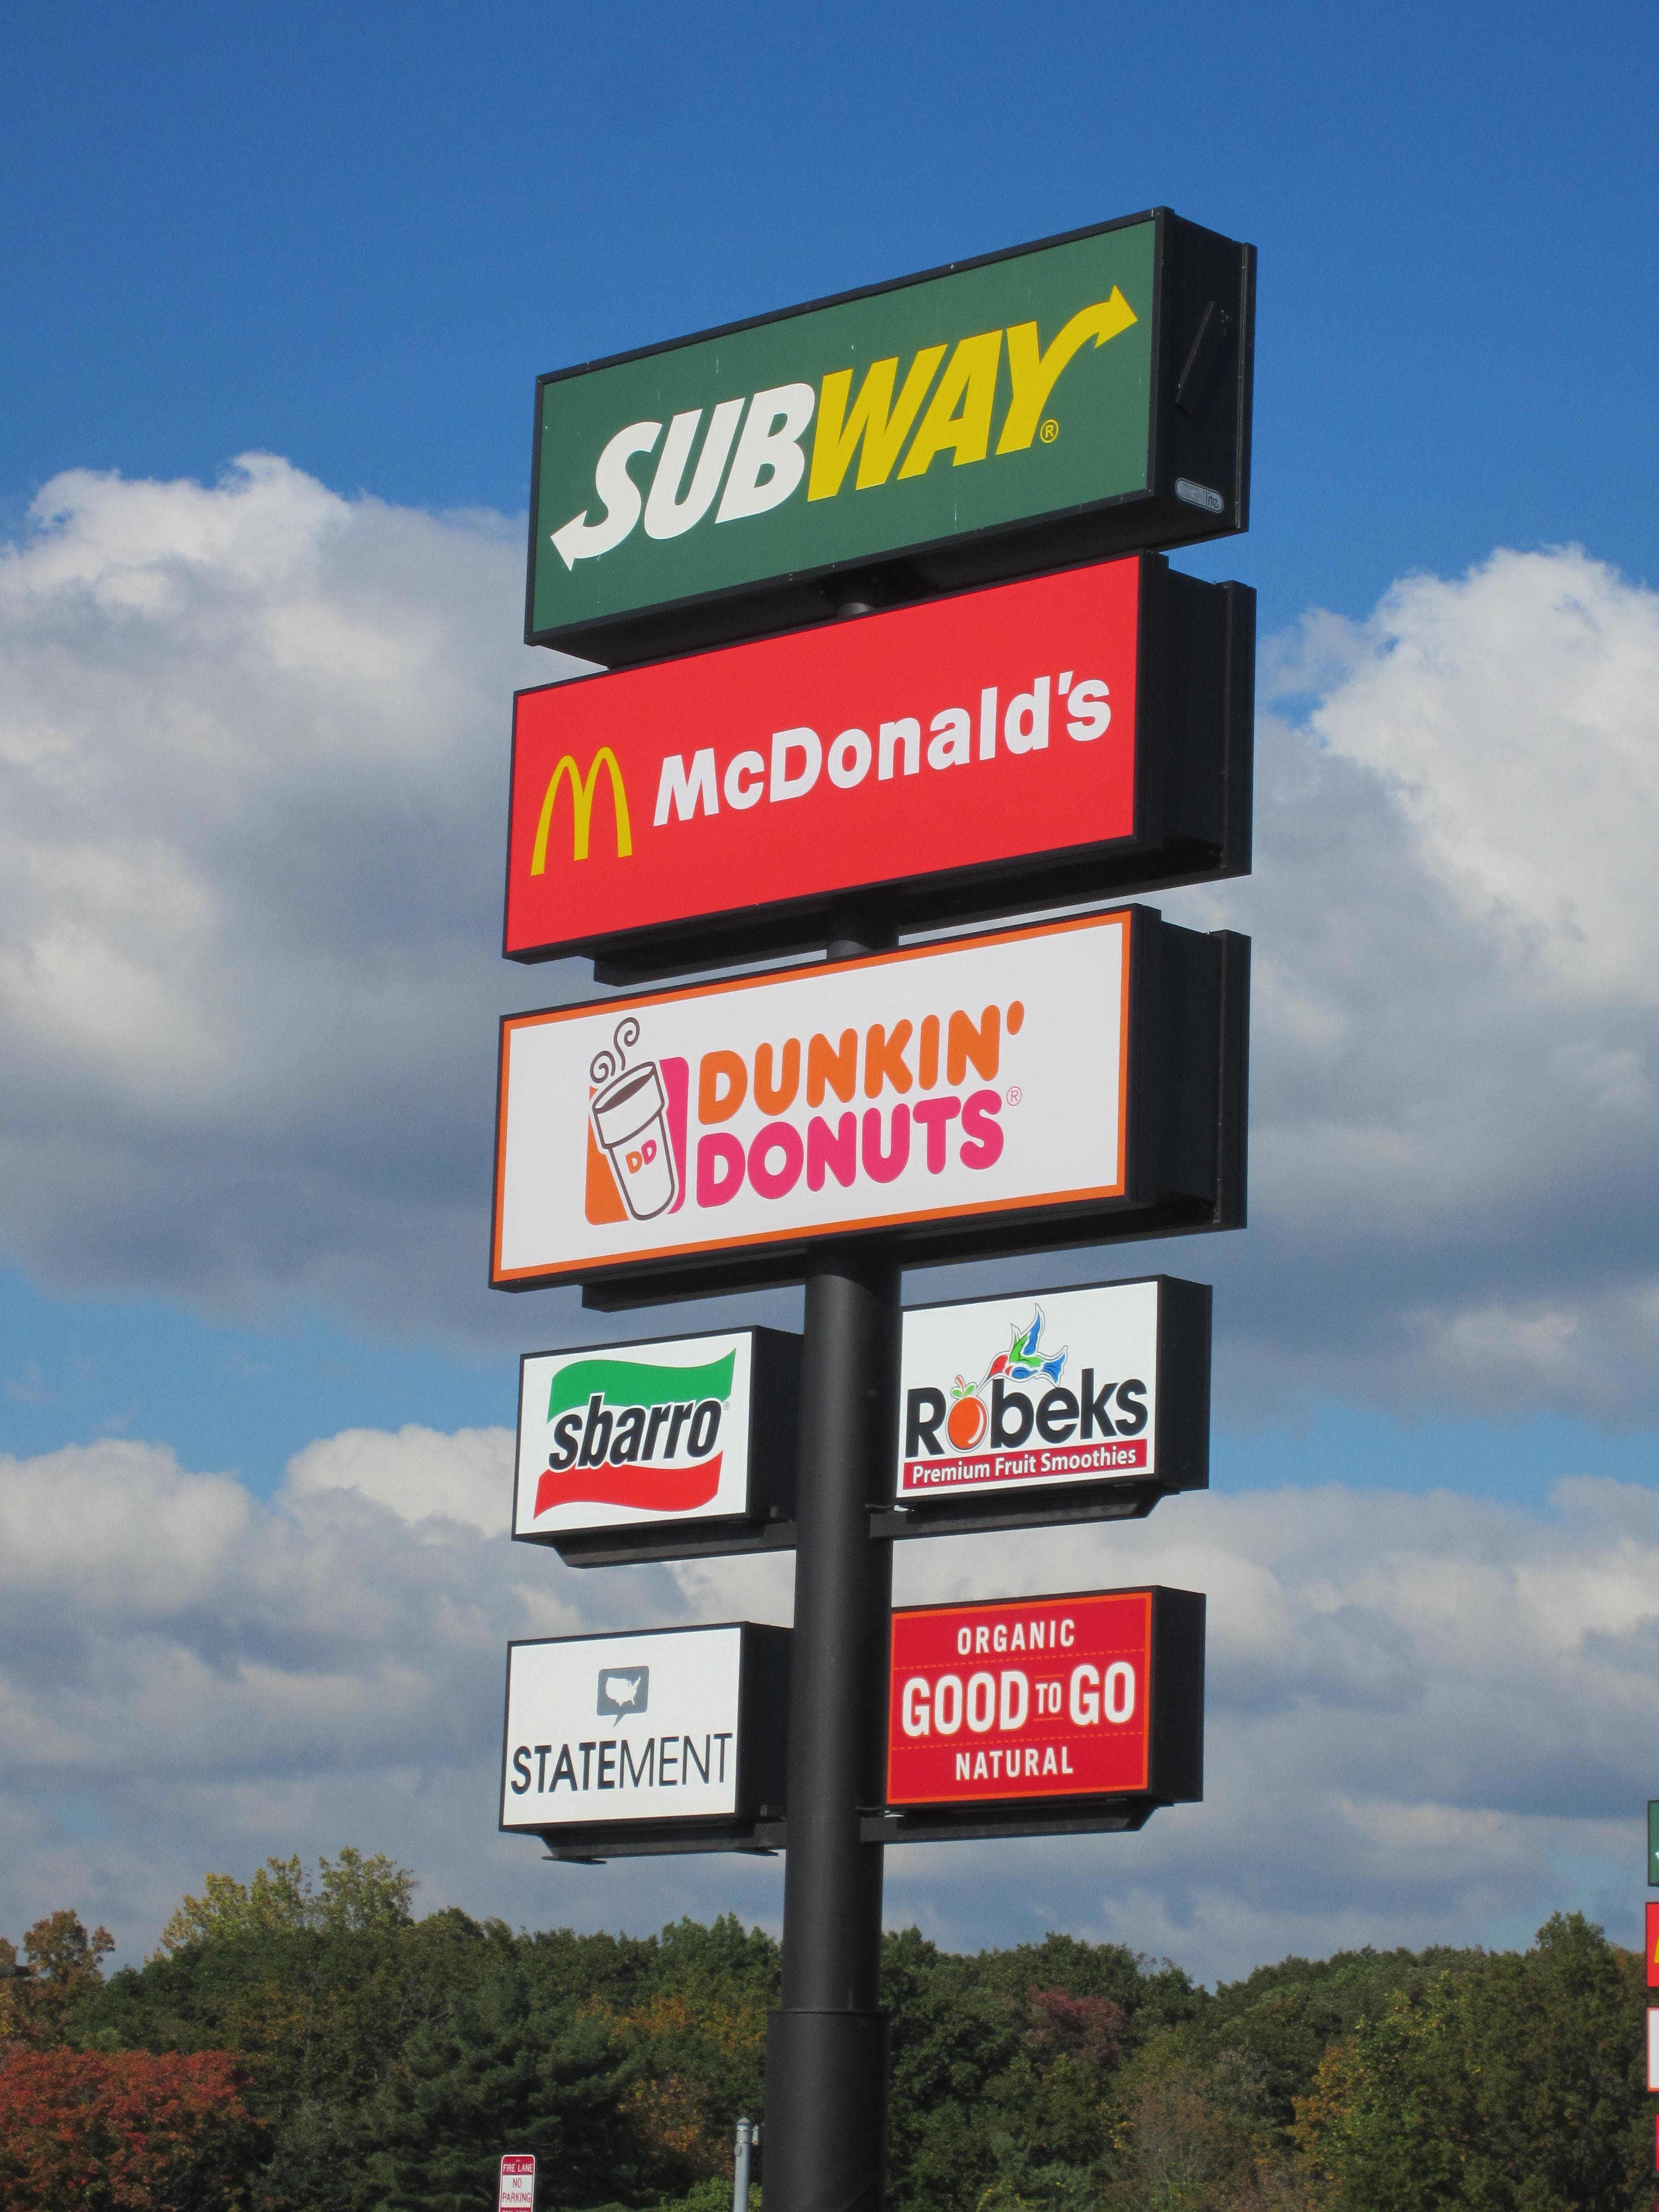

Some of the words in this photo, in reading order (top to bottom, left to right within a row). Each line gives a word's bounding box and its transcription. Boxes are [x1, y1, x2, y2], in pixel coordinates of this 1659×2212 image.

[550, 285, 1138, 571] SUBWAY
[653, 671, 1111, 826] McDonald's
[698, 1000, 1024, 1124] DUNKIN'
[626, 1138, 657, 1174] DD
[696, 1089, 1004, 1208] DONUTS
[549, 1395, 722, 1470] sbarro
[905, 1368, 1148, 1458] Robeks
[912, 1460, 990, 1484] Premium
[995, 1454, 1036, 1475] Fruit
[1041, 1446, 1136, 1471] Smoothies
[957, 1619, 1075, 1655] ORGANIC
[902, 1669, 1029, 1738] GOOD
[1036, 1682, 1062, 1714] TO
[1069, 1661, 1135, 1726] GO
[510, 1732, 733, 1796] STATEMENT
[955, 1746, 1074, 1781] NATURAL
[502, 2193, 531, 2203] PARKING
[503, 2164, 515, 2172] FIRE
[518, 2164, 533, 2172] LANE
[513, 2178, 522, 2188] NO
